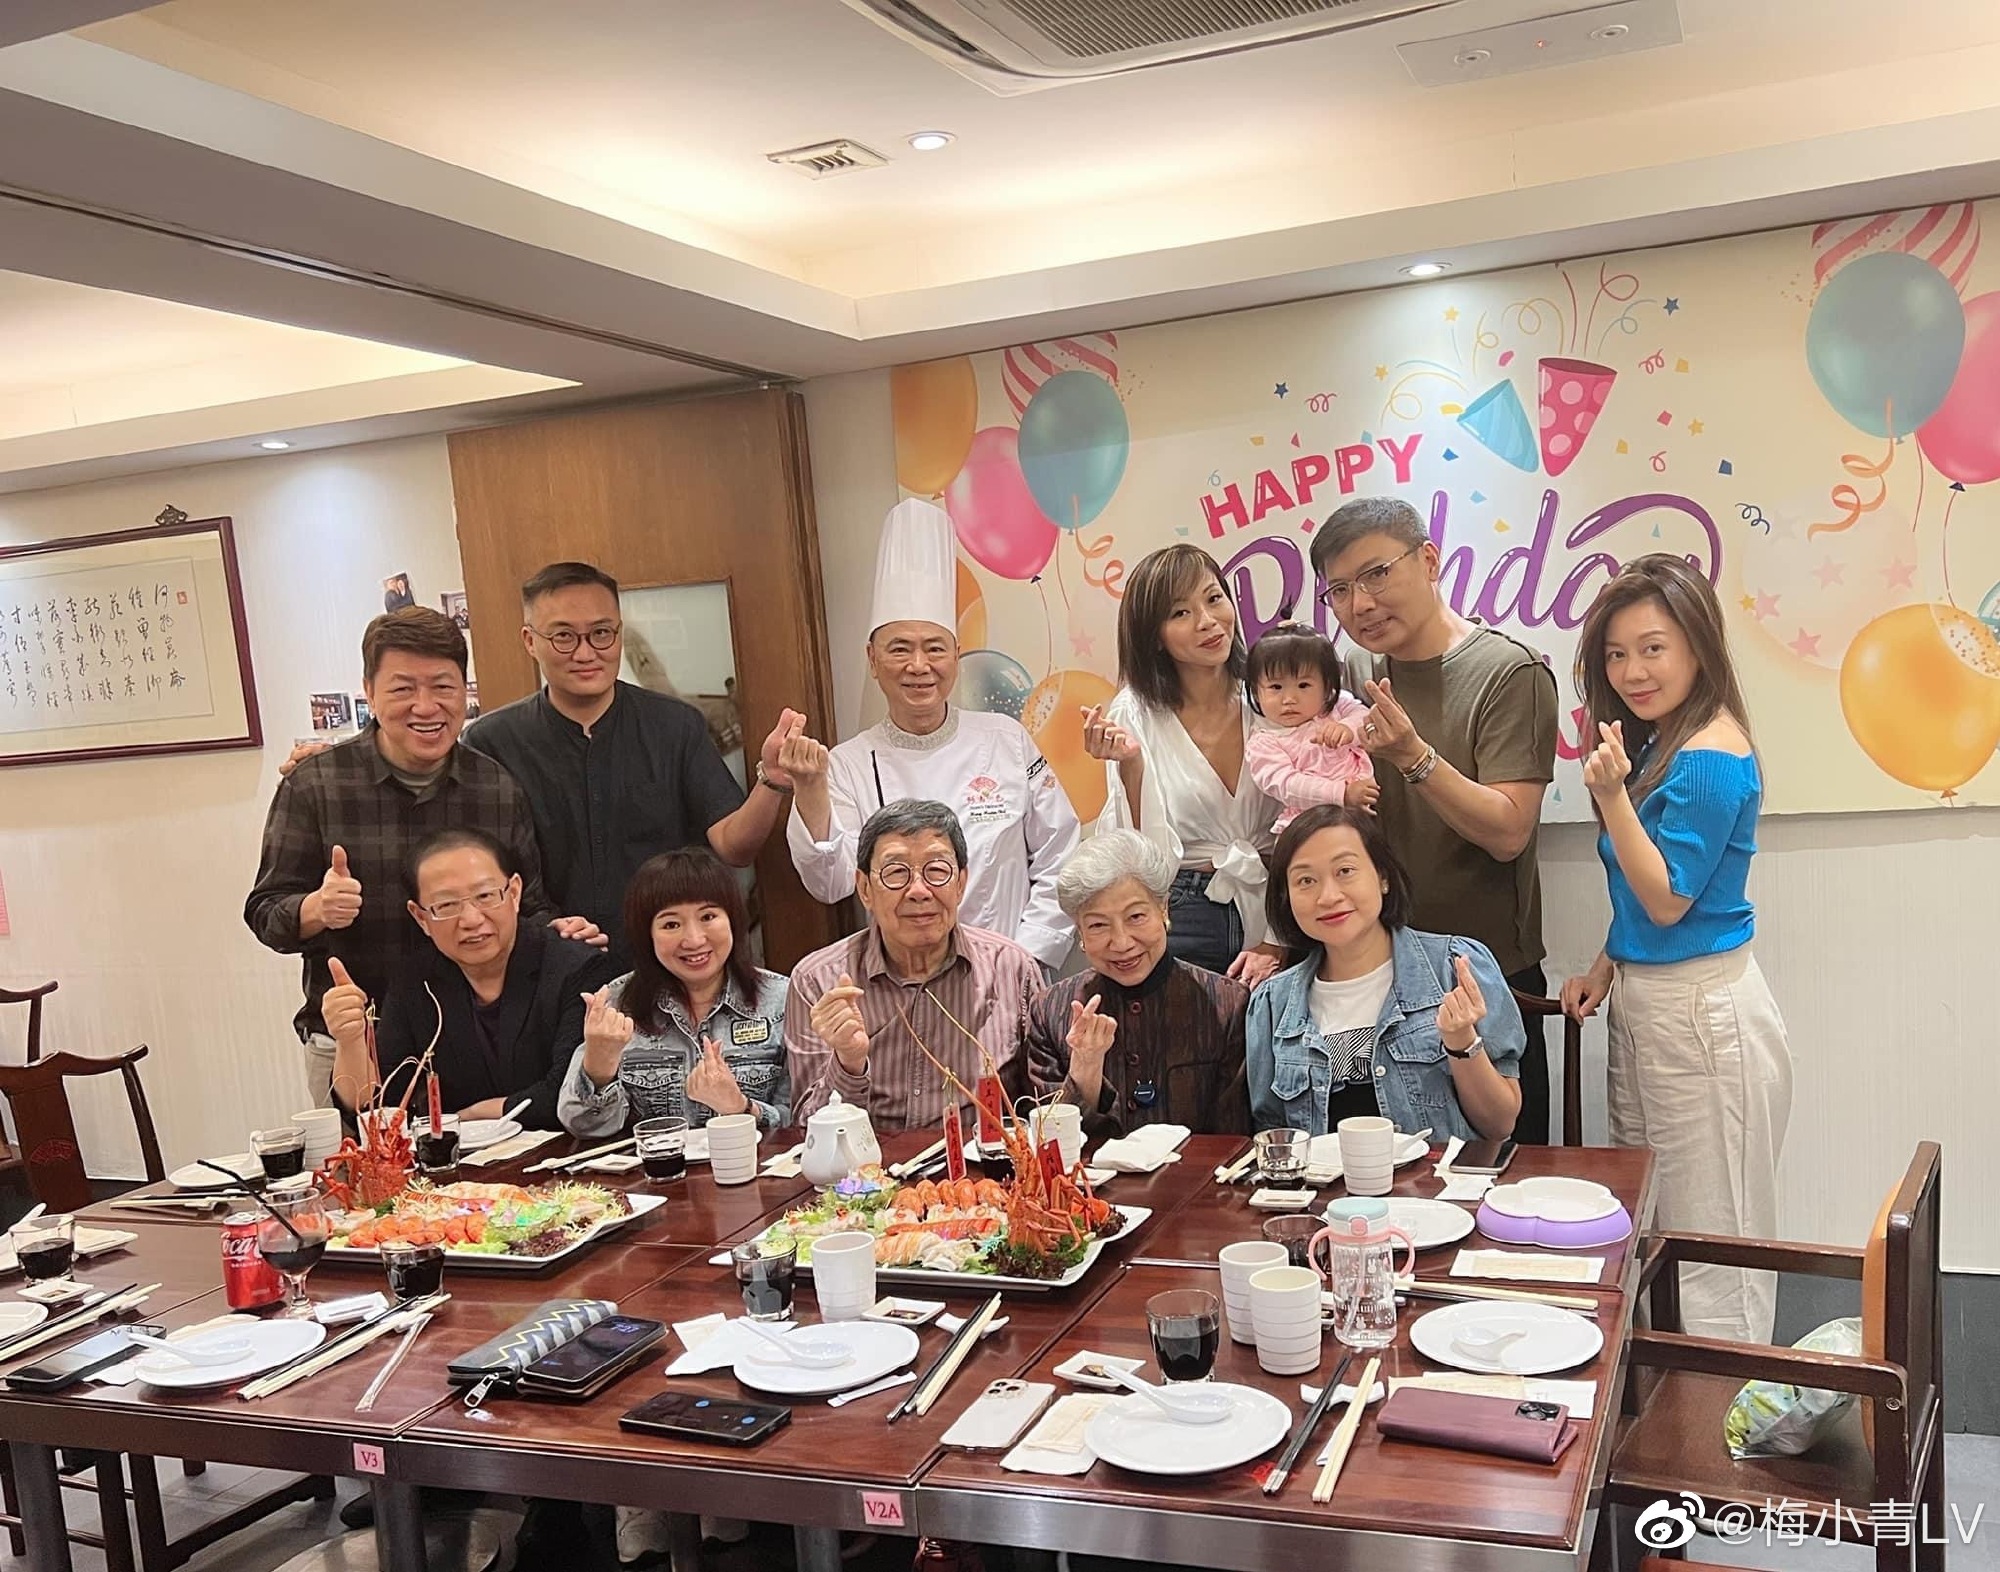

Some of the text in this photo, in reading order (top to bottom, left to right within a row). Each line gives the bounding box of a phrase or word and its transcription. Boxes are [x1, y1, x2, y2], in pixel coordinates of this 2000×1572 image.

[1200, 434, 1423, 539] HAPPY
[361, 1451, 378, 1467] V3
[866, 1501, 900, 1518] V2A
